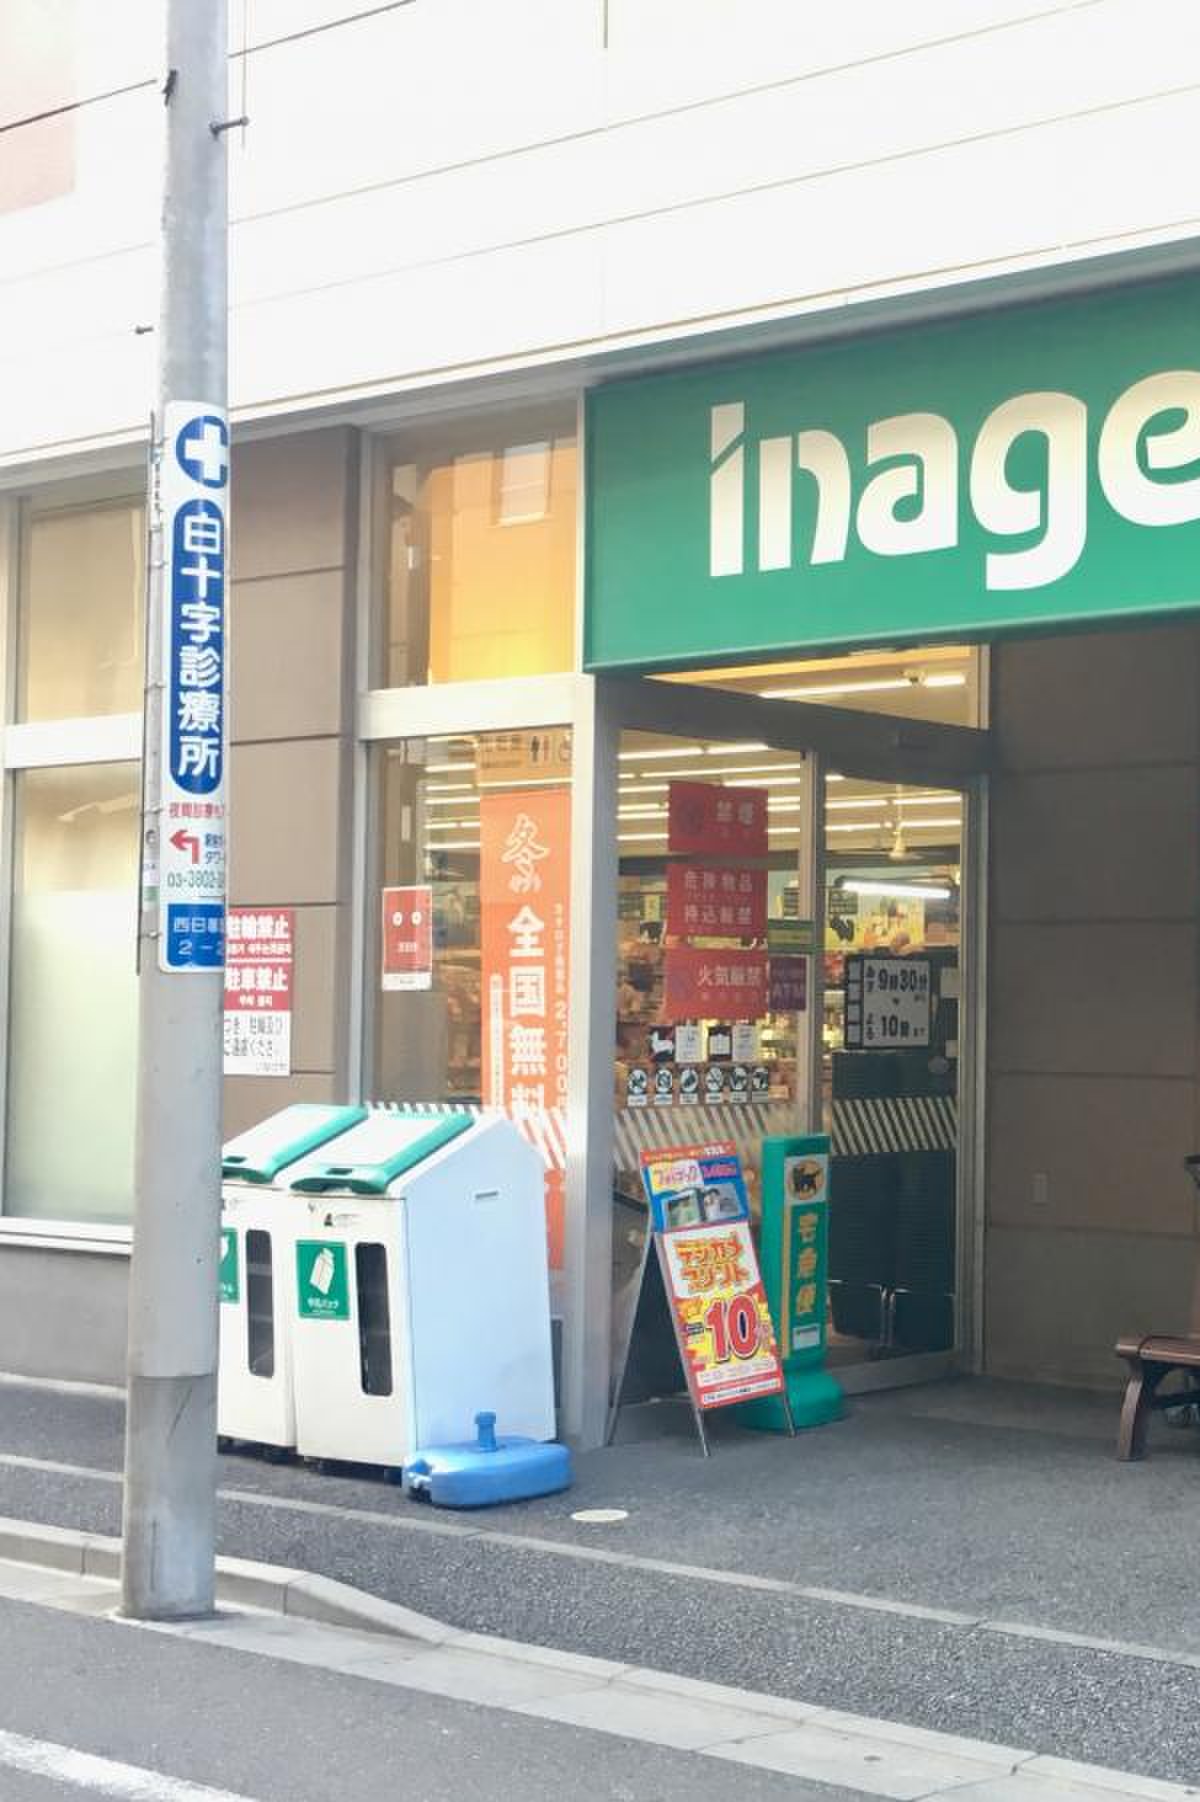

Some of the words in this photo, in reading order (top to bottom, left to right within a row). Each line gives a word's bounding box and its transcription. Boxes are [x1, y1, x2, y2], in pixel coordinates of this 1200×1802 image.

[178, 511, 221, 778] 白十字診療所
